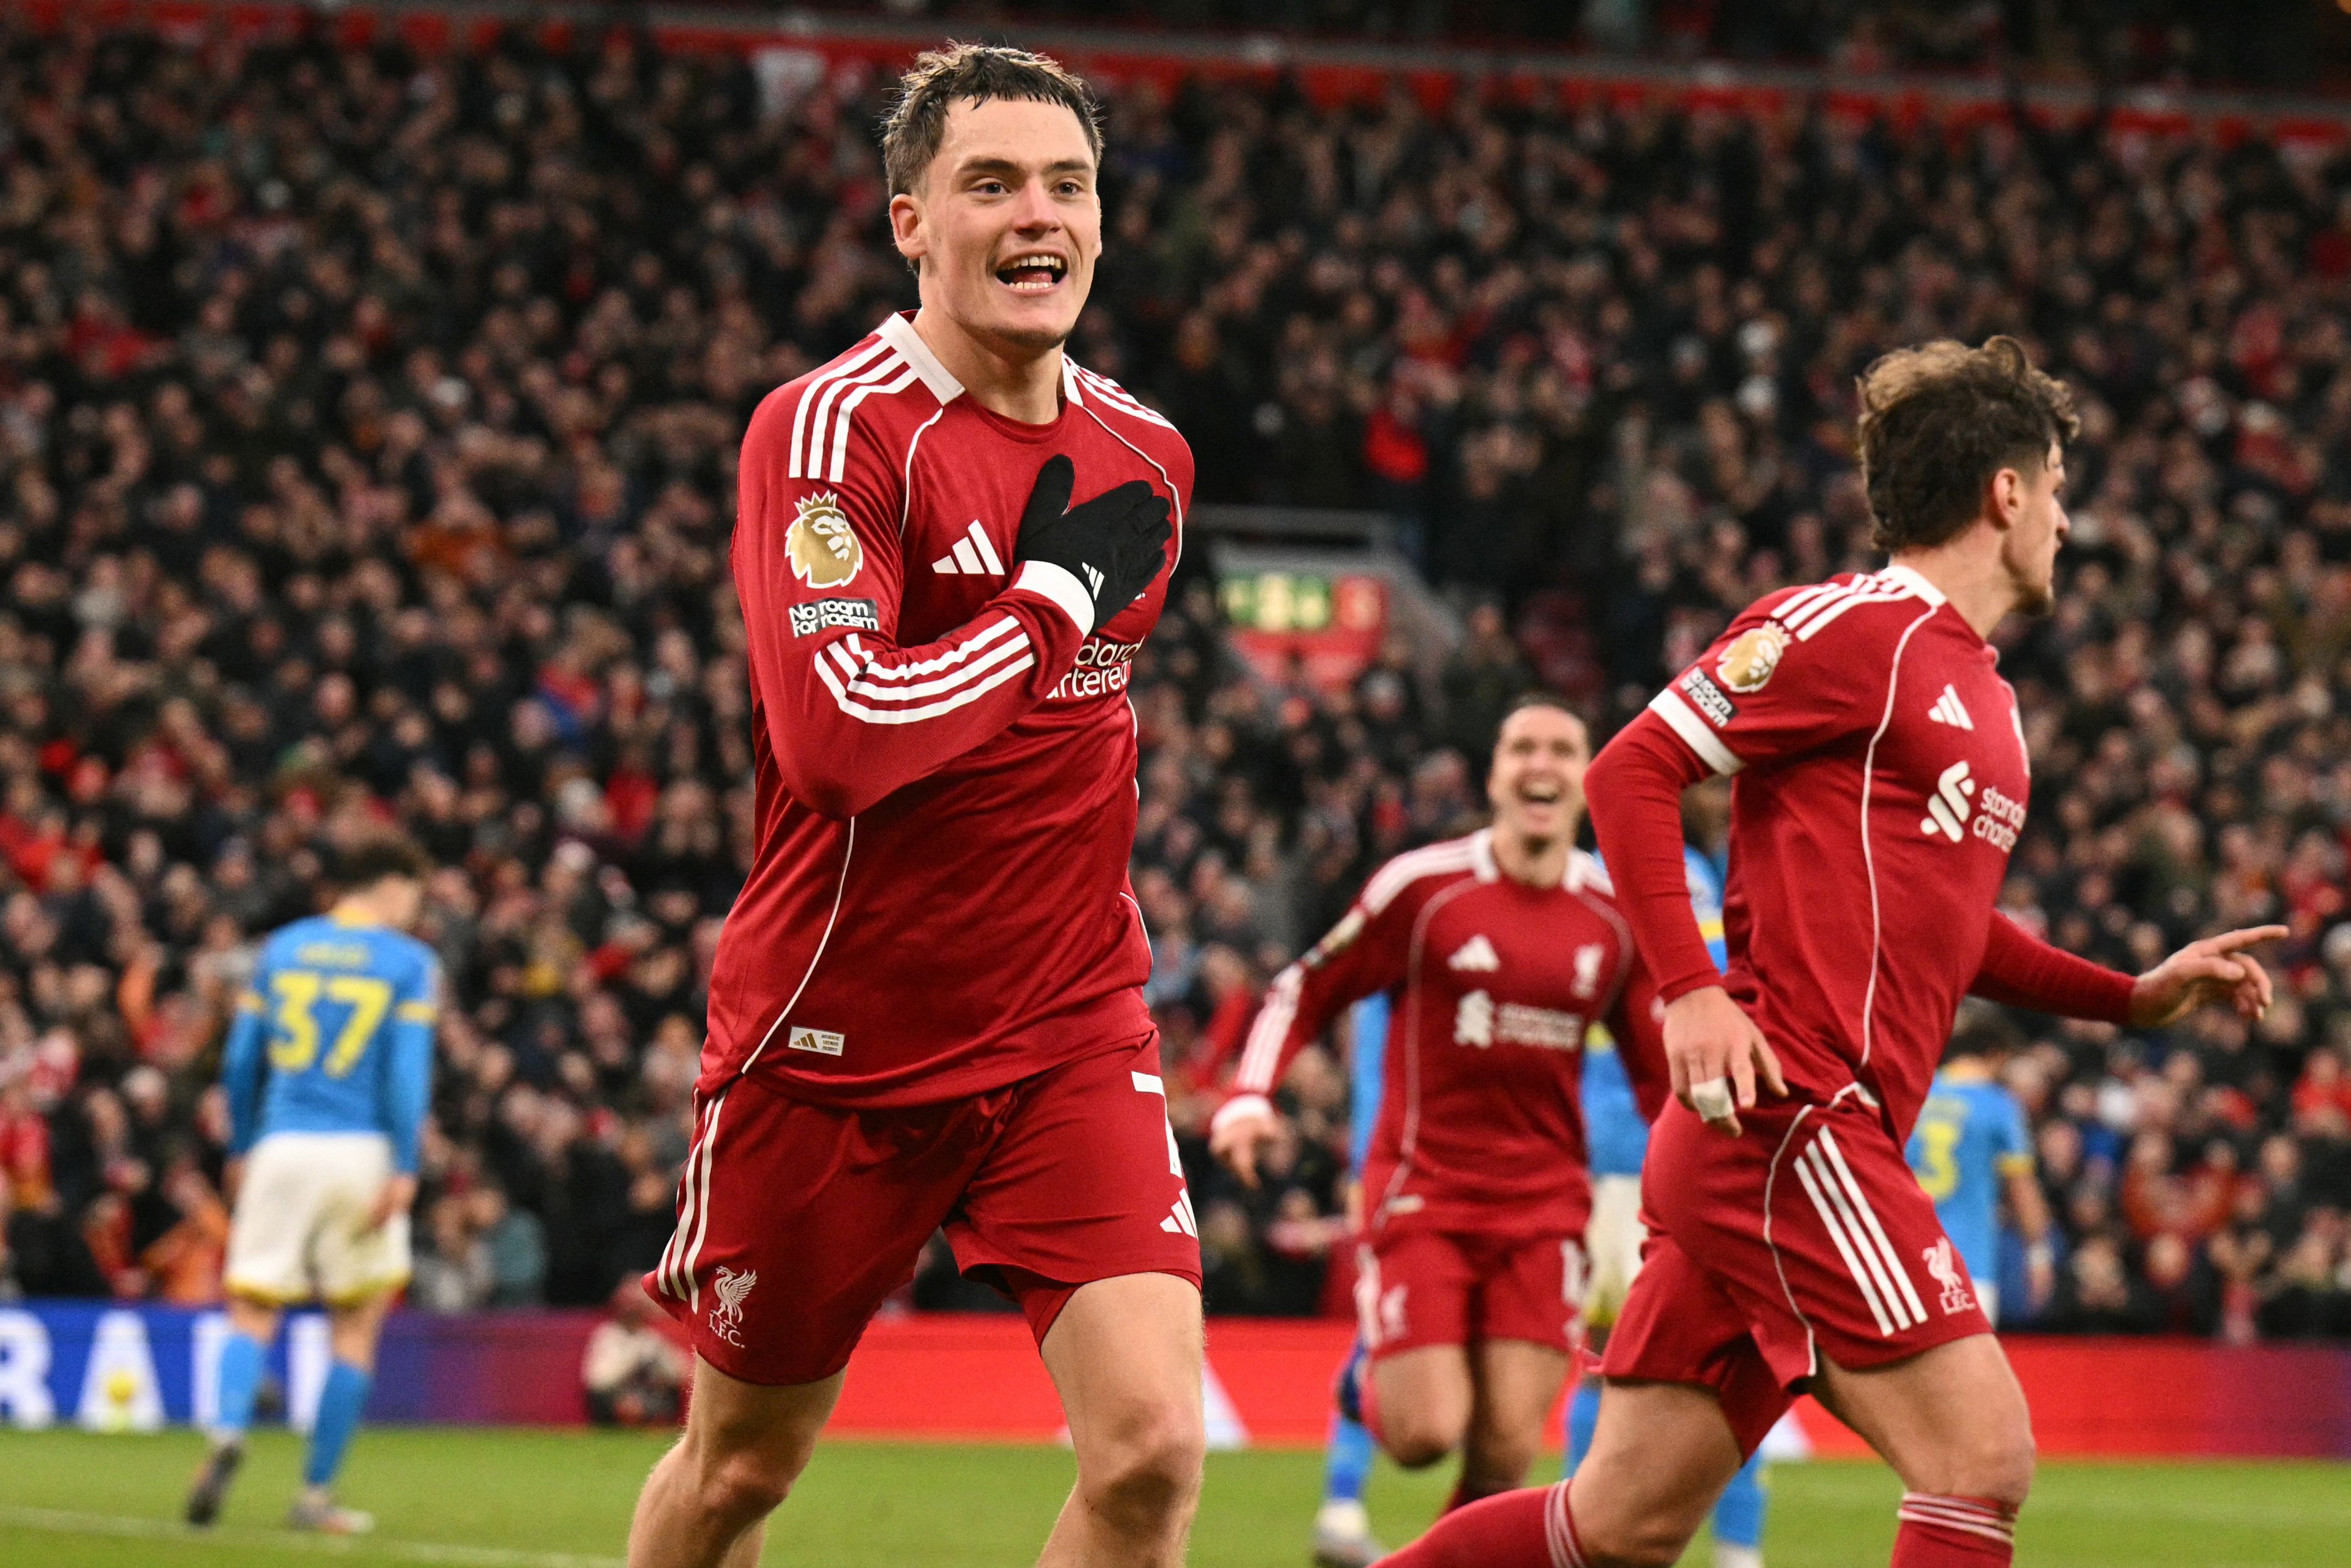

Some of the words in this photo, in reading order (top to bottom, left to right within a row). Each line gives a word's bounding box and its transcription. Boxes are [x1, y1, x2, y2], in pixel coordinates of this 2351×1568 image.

[789, 604, 816, 622] No
[819, 600, 868, 617] room
[792, 618, 818, 637] for
[820, 613, 879, 631] racism
[268, 971, 392, 1079] 37
